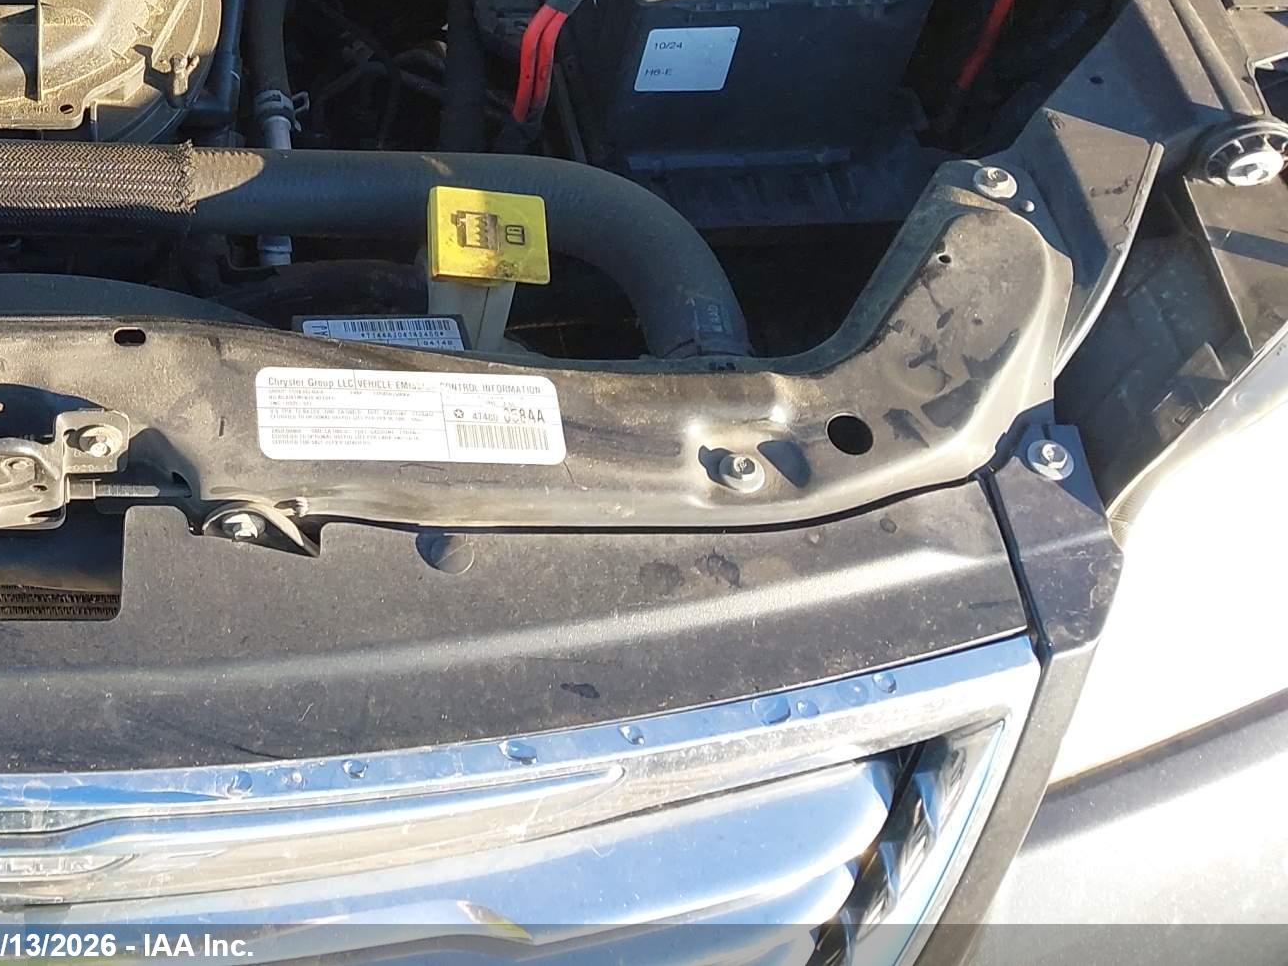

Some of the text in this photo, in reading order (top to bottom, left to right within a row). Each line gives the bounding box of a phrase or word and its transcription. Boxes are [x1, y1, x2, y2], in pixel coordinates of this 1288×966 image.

[654, 41, 684, 51] 10/24
[268, 377, 305, 388] Chrysler
[307, 378, 335, 390] Group
[337, 379, 354, 388] LLC
[357, 380, 391, 390] VEHICLE
[482, 384, 542, 395] INFORMATION
